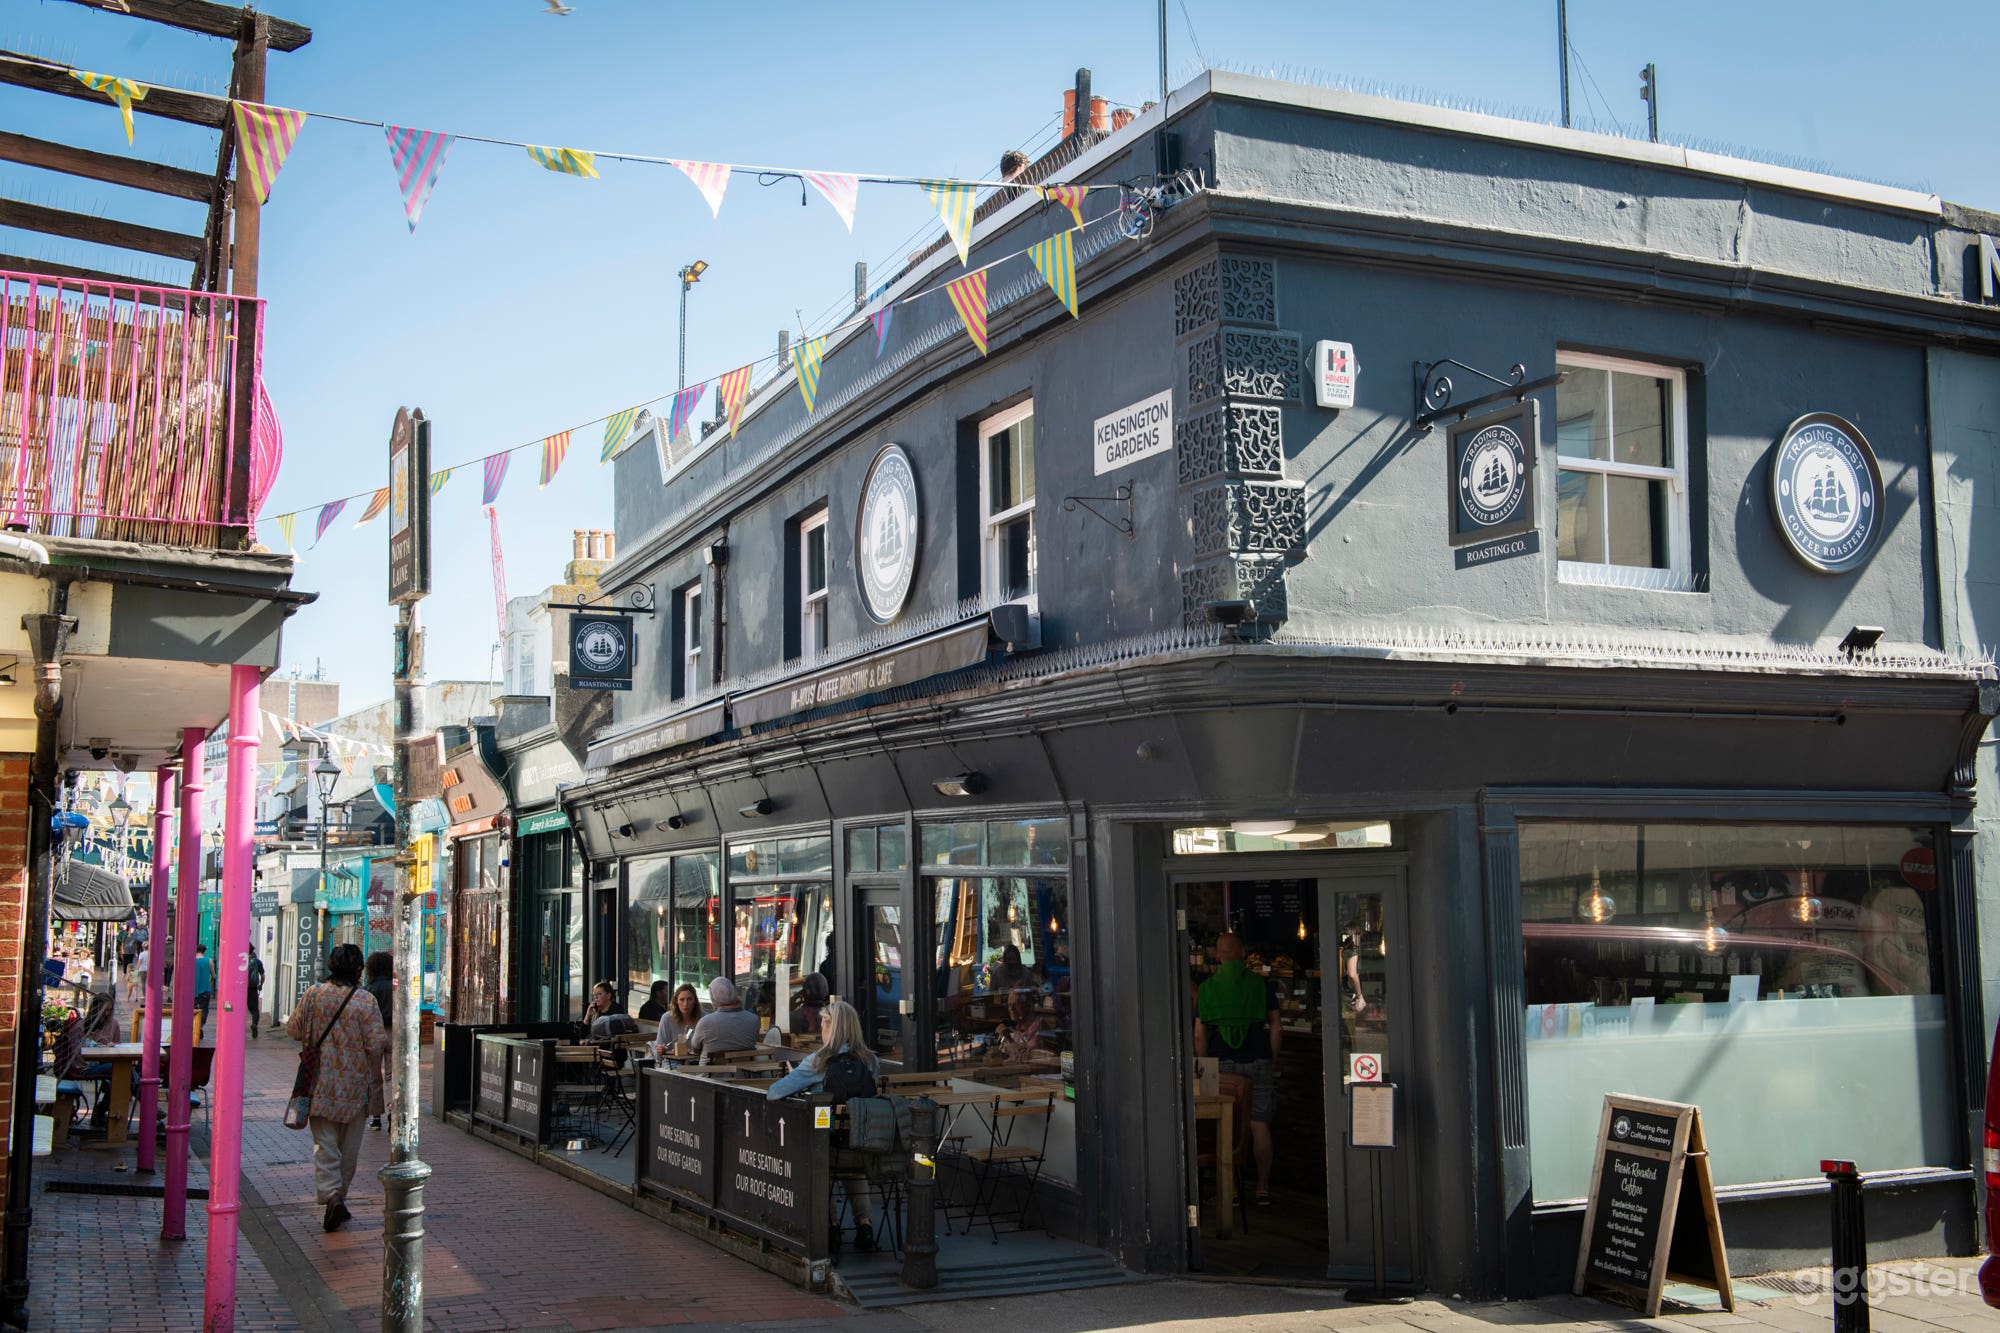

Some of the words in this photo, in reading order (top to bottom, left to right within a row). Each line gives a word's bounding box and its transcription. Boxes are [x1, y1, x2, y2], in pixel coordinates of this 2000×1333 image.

[1325, 373, 1350, 384] HAVEN
[1097, 400, 1169, 446] KENSINGTON
[1106, 427, 1159, 463] GARDENS
[1466, 429, 1498, 463] TRADING
[1499, 430, 1519, 451] POST
[1786, 429, 1833, 462] TRADING
[1837, 438, 1864, 471] POST
[866, 461, 894, 513] TRADING
[896, 462, 912, 494] POST
[1466, 499, 1489, 521] COFFEE
[1490, 487, 1521, 521] ROASTERS
[391, 537, 410, 564] NORTH
[1788, 514, 1820, 553] COFFEE
[1823, 523, 1866, 557] ROASTERS
[1466, 544, 1510, 563] ROASTING
[1511, 540, 1527, 553] CO.
[392, 563, 409, 587] LAINE
[866, 573, 885, 607] COFFEE
[885, 557, 912, 607] ROASTERS
[581, 623, 606, 638] TRADING
[607, 626, 620, 638] POST
[817, 678, 840, 702] COFFEE
[839, 668, 869, 697] ROASTING
[869, 668, 876, 689] &
[659, 1123, 673, 1143] MORE
[673, 1126, 693, 1148] SEATING
[693, 1134, 700, 1150] IN
[1630, 1131, 1647, 1140] Coffee
[1648, 1134, 1671, 1146] Roastery
[1636, 1122, 1656, 1133] Trading
[1656, 1126, 1669, 1135] Post
[657, 1146, 668, 1161] OUR
[668, 1149, 681, 1168] ROOF
[681, 1155, 702, 1176] GARDEN
[739, 1148, 757, 1168] MORE
[757, 1153, 783, 1176] SEATING
[784, 1161, 792, 1179] IN
[1614, 1158, 1631, 1175] Fresh
[1631, 1162, 1657, 1180] Roasted
[735, 1173, 749, 1192] OUR
[749, 1178, 767, 1199] ROOF
[767, 1184, 794, 1208] GARDEN
[1621, 1177, 1643, 1197] Coffee
